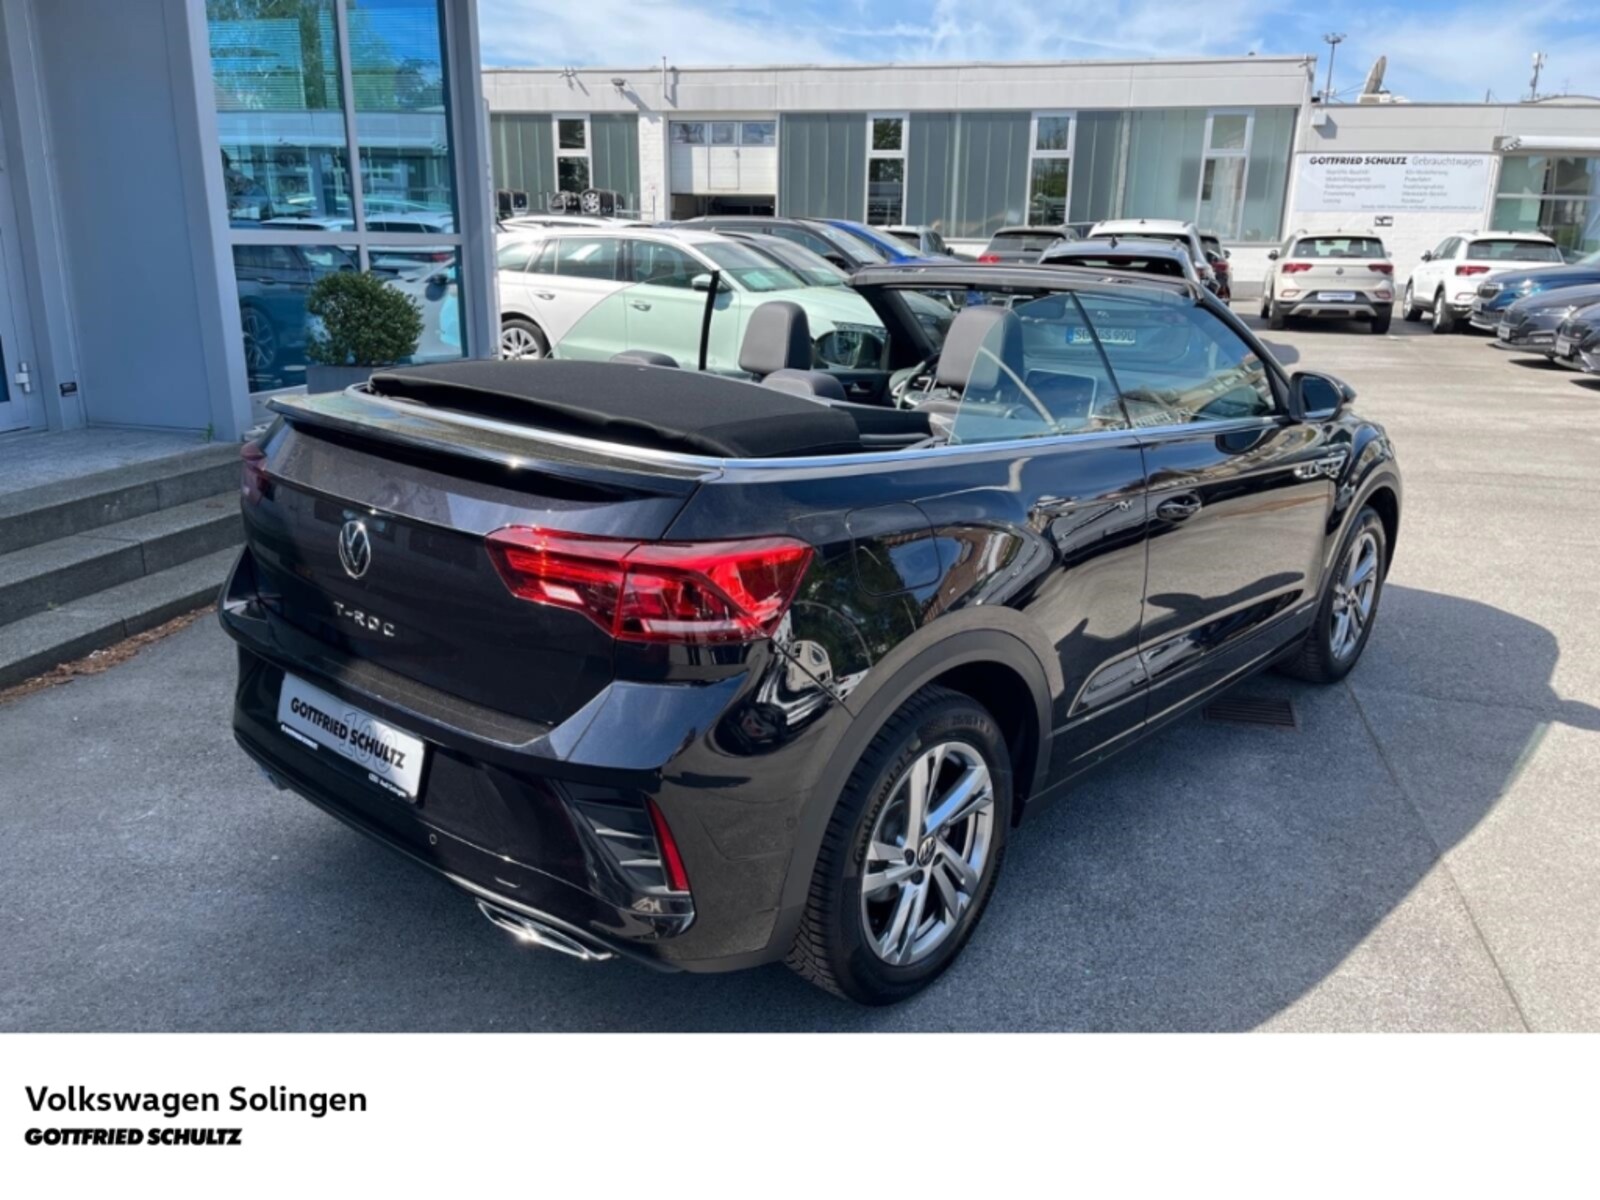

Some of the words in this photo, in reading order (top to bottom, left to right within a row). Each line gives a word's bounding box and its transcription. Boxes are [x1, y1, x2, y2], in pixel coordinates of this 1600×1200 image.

[1309, 156, 1363, 165] GOTTFRIED
[1364, 156, 1407, 165] SCHULTZ
[1411, 157, 1484, 168] Gebrauchtwagen
[333, 601, 395, 637] T-ROC
[290, 697, 348, 740] GOTTFRIED
[350, 729, 406, 770] SCHULTZ
